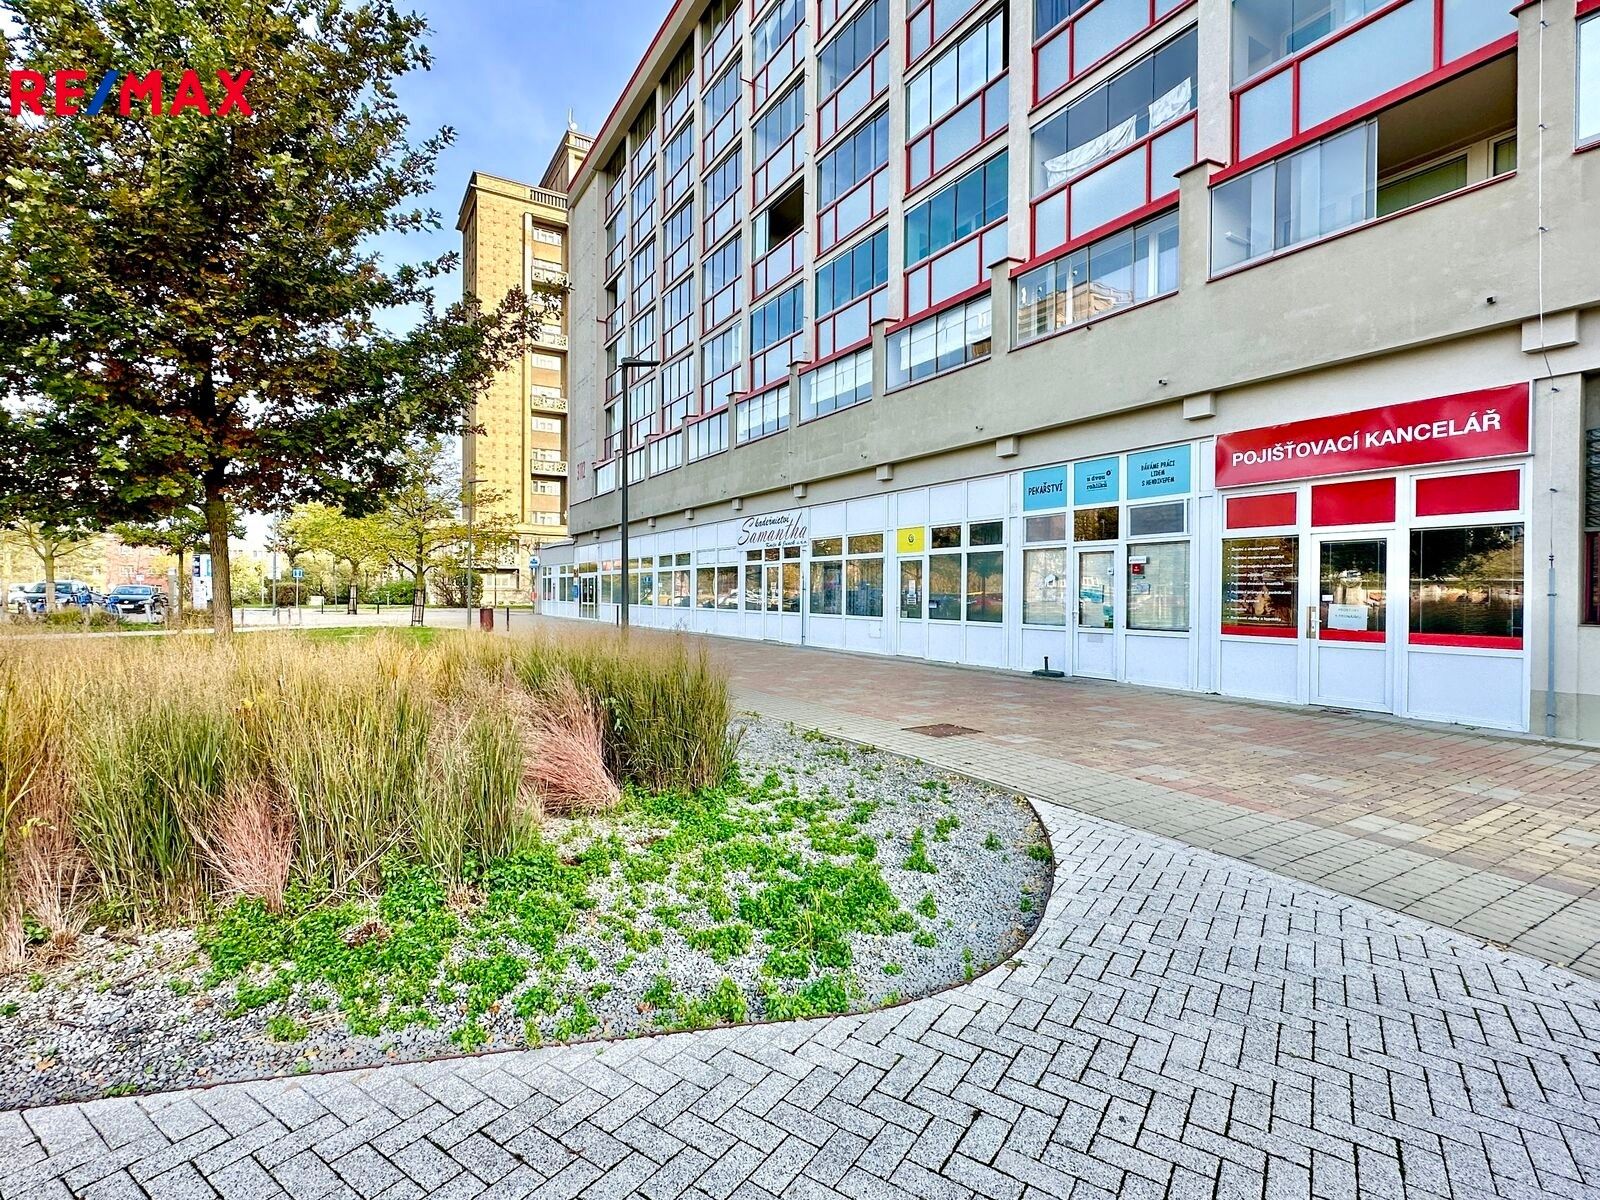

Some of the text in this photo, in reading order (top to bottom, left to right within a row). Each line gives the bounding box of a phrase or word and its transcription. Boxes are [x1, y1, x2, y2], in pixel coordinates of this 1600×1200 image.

[1231, 409, 1502, 467] POJIŠŤOVACÍ KANCELÁŘ
[1141, 459, 1175, 471] DÁVÁME PRÁCI
[1150, 469, 1165, 477] LIDEM
[1028, 480, 1063, 496] PEKAŘSTVÍ
[737, 511, 808, 546] Samantha
